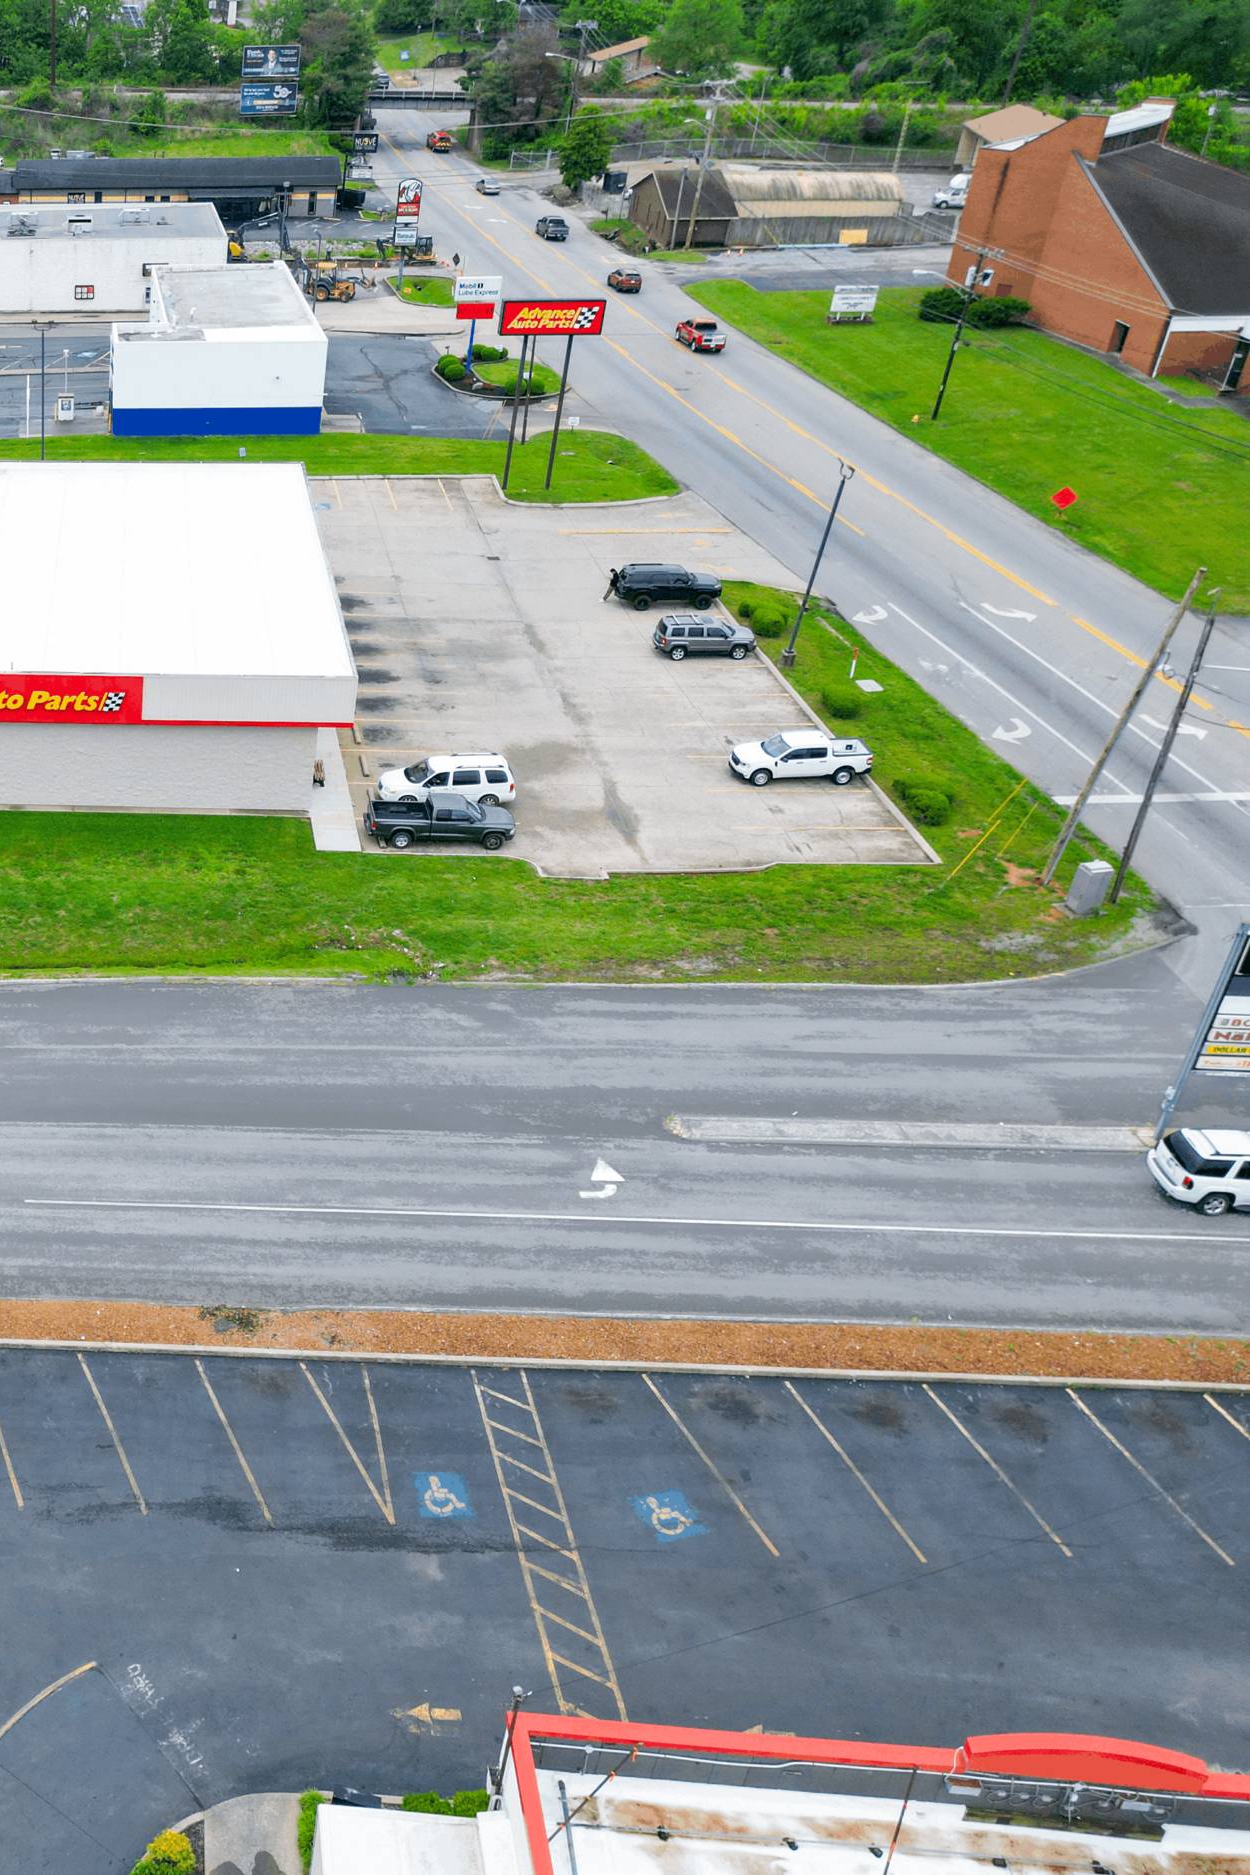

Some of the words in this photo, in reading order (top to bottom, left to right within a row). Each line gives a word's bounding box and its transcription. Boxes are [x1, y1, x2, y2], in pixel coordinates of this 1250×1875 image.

[516, 307, 576, 319] Advance
[507, 319, 538, 329] Auto
[538, 319, 572, 329] Parts
[27, 690, 100, 711] Parts
